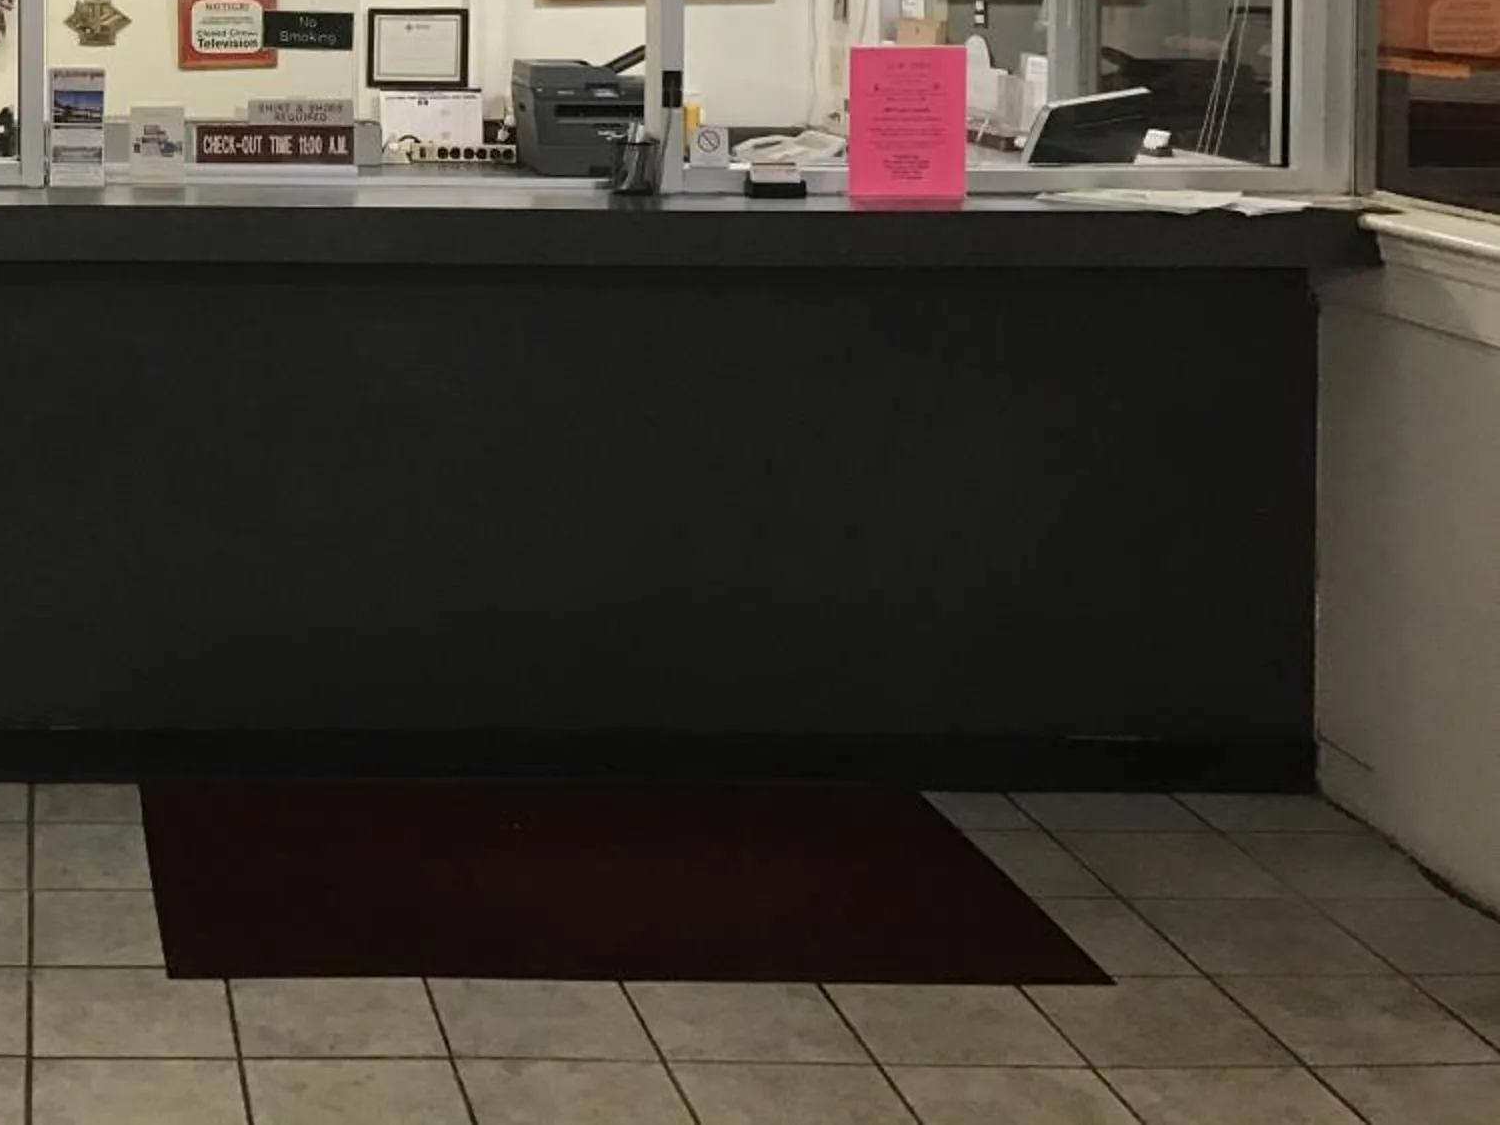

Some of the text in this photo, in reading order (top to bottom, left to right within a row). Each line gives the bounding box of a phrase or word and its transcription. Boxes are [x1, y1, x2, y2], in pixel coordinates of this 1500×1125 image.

[299, 16, 318, 28] No
[197, 37, 259, 49] Television
[279, 29, 338, 46] Smoking
[202, 134, 263, 155] CHECK-OUT
[269, 134, 294, 155] TIME
